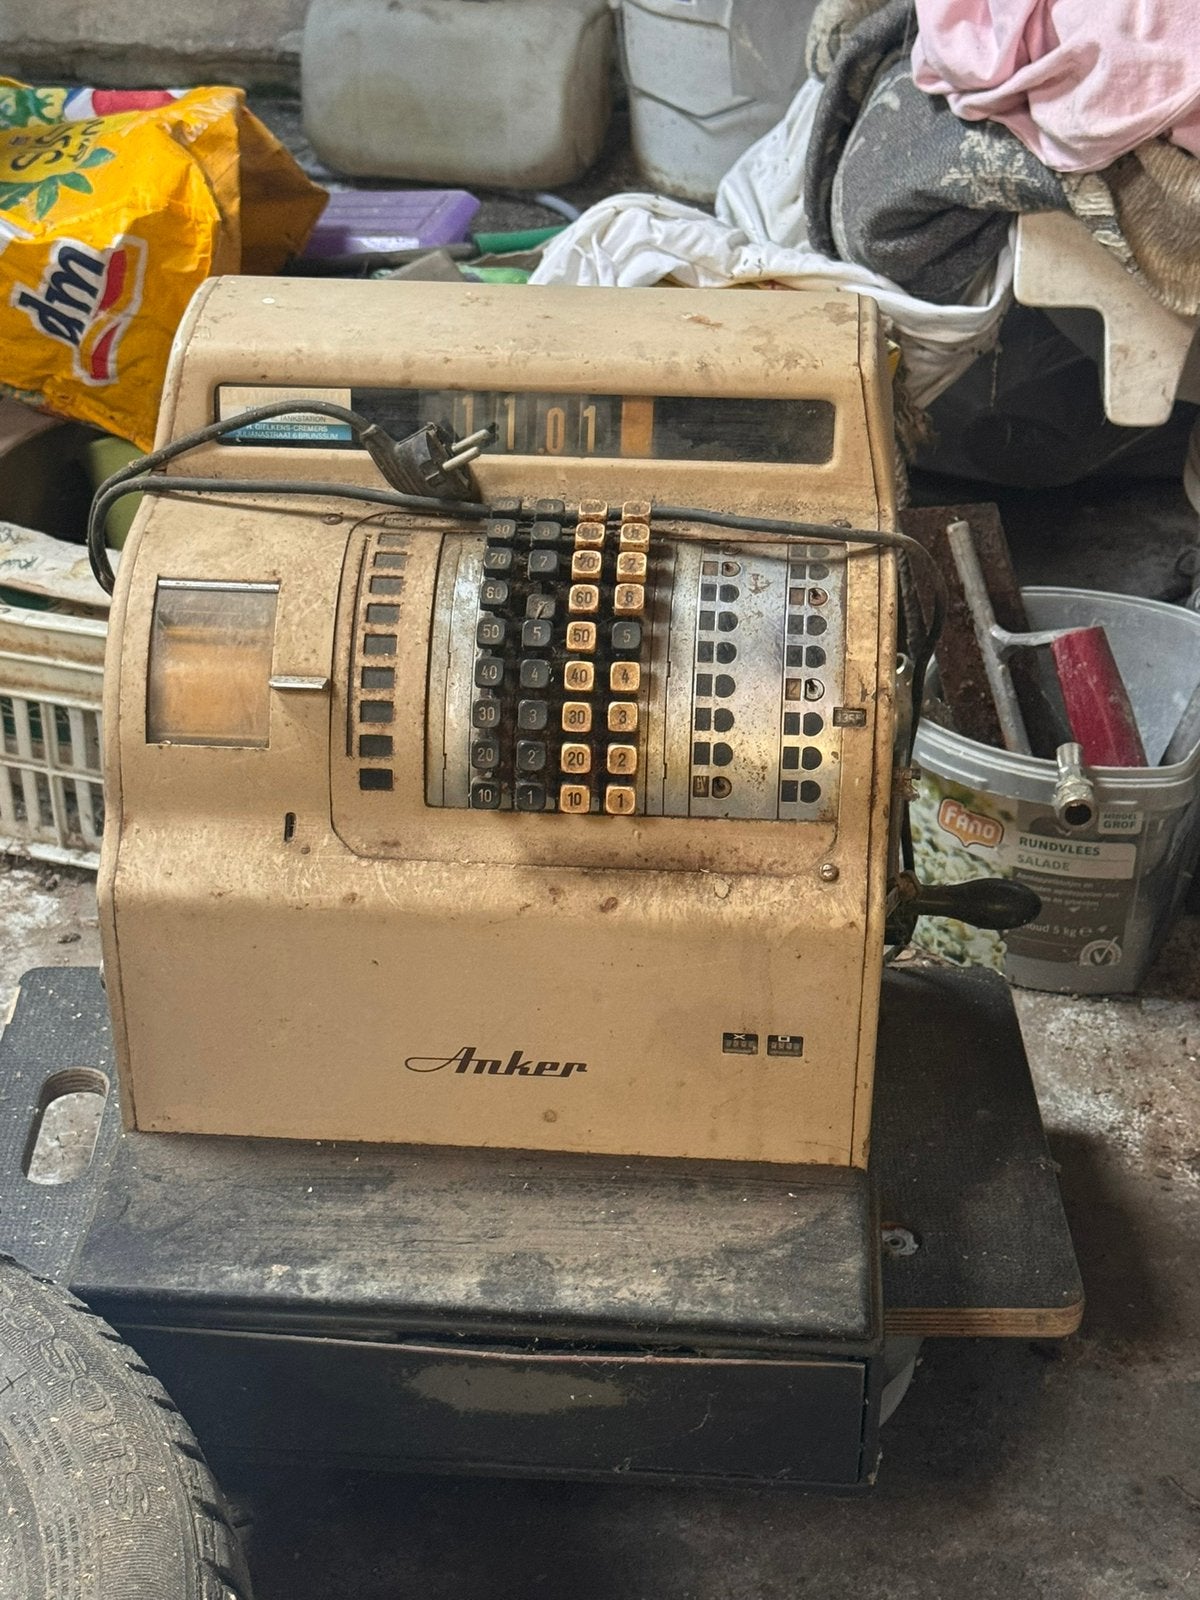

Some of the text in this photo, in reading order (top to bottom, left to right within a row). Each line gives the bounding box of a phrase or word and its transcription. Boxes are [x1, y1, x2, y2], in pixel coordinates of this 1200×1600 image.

[18, 245, 106, 346] dm
[494, 525, 510, 533] 80
[490, 553, 506, 564] 70
[540, 557, 547, 567] 7
[628, 558, 635, 569] 7
[486, 587, 502, 598] 60
[577, 592, 592, 604] 60
[626, 591, 633, 602] 6
[482, 625, 500, 639] 50
[534, 627, 541, 641] 5
[574, 628, 590, 643] 50
[623, 630, 631, 643] 5
[481, 664, 498, 679] 40
[531, 667, 538, 681] 4
[571, 669, 588, 684] 40
[621, 670, 629, 684] 4
[479, 706, 495, 720] 30
[529, 709, 537, 722] 3
[569, 710, 585, 724] 30
[619, 711, 627, 724] 3
[478, 747, 493, 762] 20
[528, 750, 538, 763] 2
[568, 751, 584, 766] 20
[618, 753, 626, 767] 2
[478, 789, 492, 803] 10
[528, 789, 533, 804] 1
[568, 792, 581, 807] 10
[618, 793, 623, 808] 1
[1103, 820, 1137, 829] GROF
[1019, 837, 1100, 857] RUNDVLEES
[1017, 855, 1070, 872] SALADE
[1052, 925, 1060, 934] 5
[1063, 927, 1077, 937] kg
[404, 1046, 588, 1079] Anker
